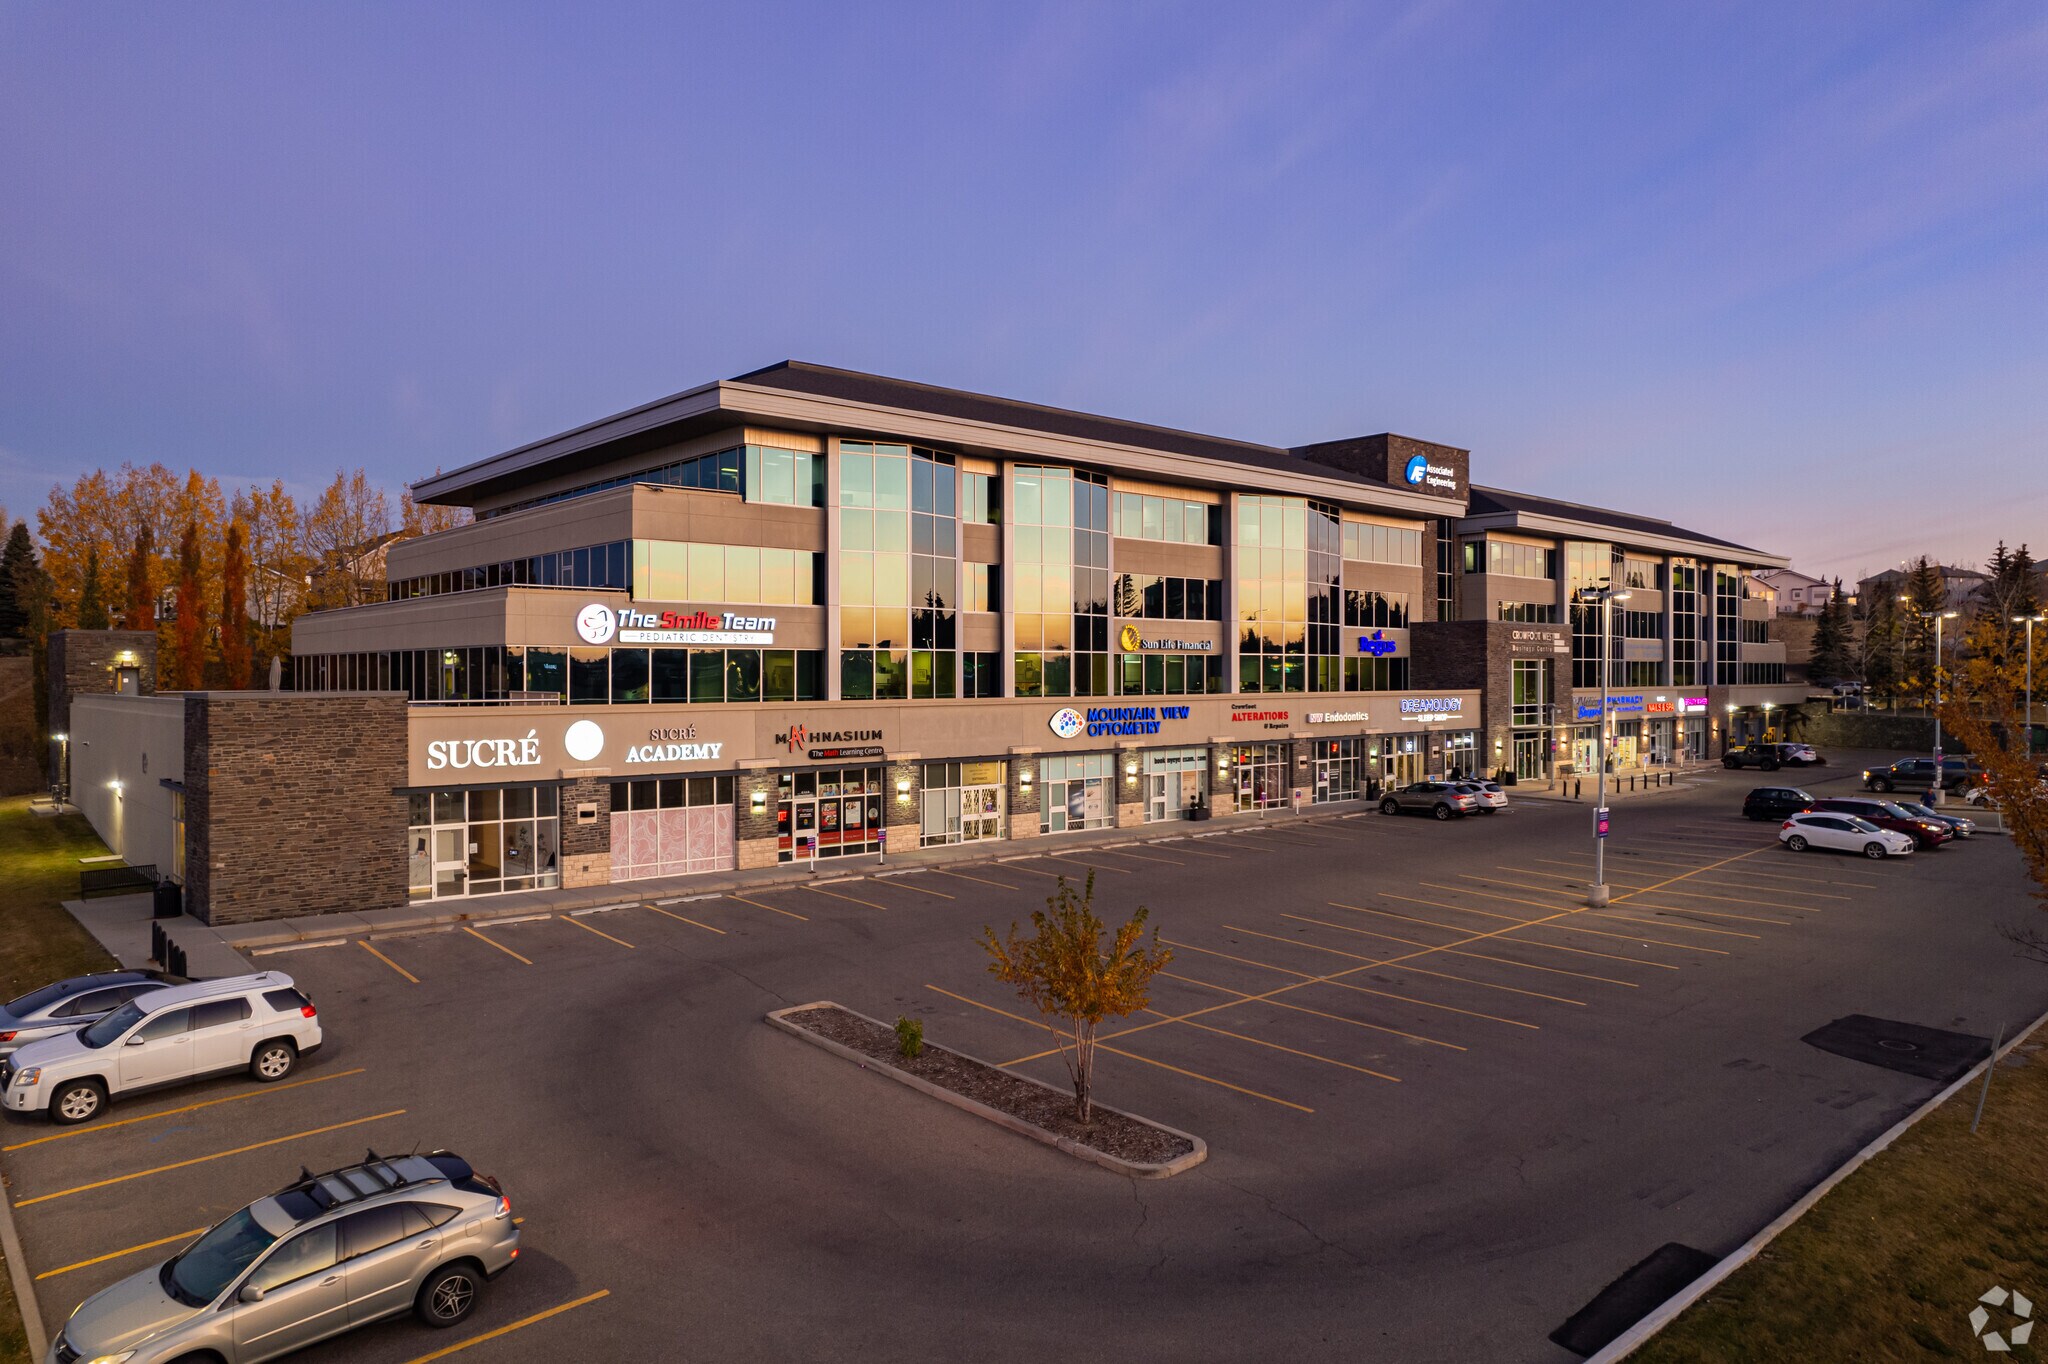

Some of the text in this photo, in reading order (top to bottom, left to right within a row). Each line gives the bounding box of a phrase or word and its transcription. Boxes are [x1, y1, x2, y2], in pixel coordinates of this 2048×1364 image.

[1427, 464, 1454, 477] Associated
[1427, 475, 1456, 490] Engineering
[618, 609, 776, 631] The Smile Team
[639, 632, 754, 642] PEDIATRIC DENTISTRY
[1141, 639, 1213, 650] Sun Life Financial
[1358, 636, 1396, 656] Regus
[1401, 698, 1462, 713] DREAMOLOGY
[1087, 706, 1190, 722] MOUNTAIN VIEW
[1231, 711, 1289, 721] ALTERATIONS
[1325, 711, 1369, 722] Endodontics
[650, 724, 697, 742] SUCRÉ
[1087, 721, 1161, 737] OPTOMETRY
[427, 729, 541, 769] SUCRÉ
[625, 743, 723, 763] ACADEMY
[823, 749, 839, 757] Math
[839, 748, 864, 757] Learning
[864, 747, 883, 755] Centre
